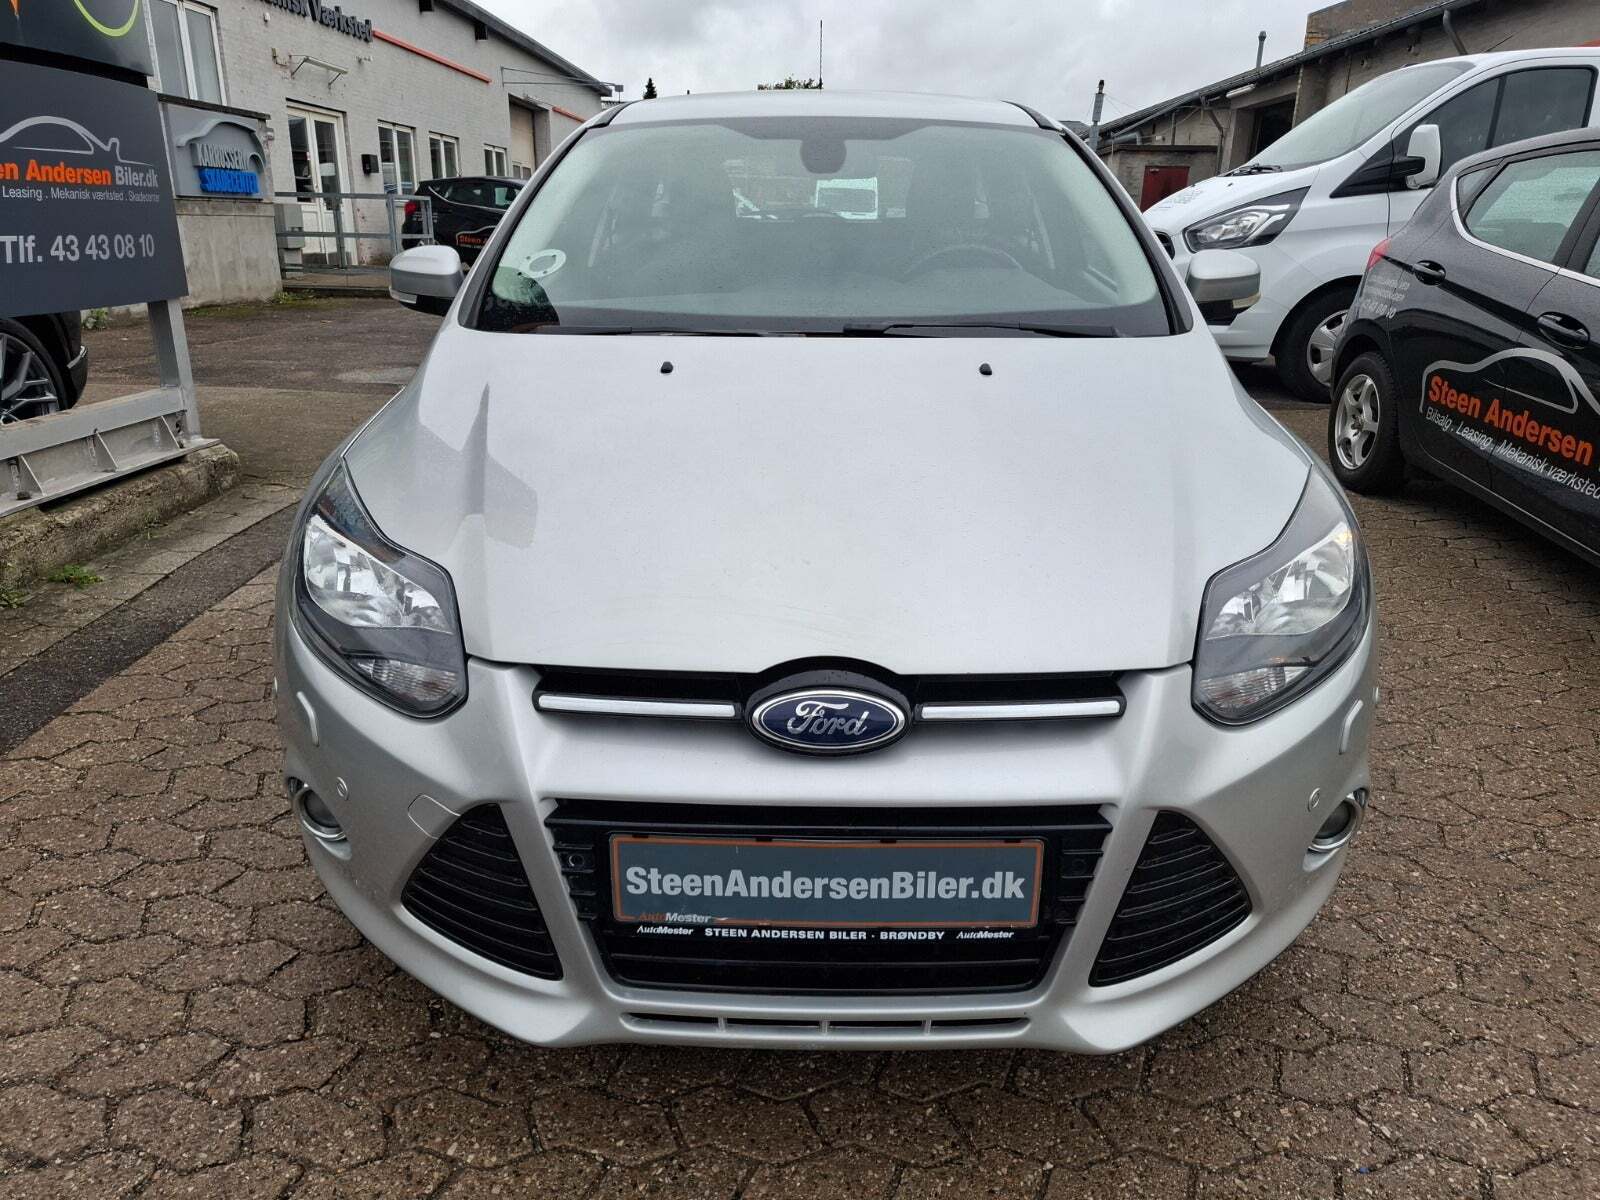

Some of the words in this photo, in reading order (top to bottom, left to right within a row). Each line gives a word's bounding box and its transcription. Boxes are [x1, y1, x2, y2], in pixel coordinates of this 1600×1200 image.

[307, 0, 372, 42] Værksted
[26, 159, 112, 185] Andersen
[114, 165, 159, 188] Biler.dk
[2, 185, 43, 202] Leasing
[51, 186, 91, 200] Mekanisk
[0, 235, 43, 263] Tlf.
[50, 235, 80, 261] 43
[85, 234, 110, 260] 43
[114, 233, 136, 259] 08
[139, 233, 155, 257] 10
[1429, 375, 1480, 418] Steen
[1484, 399, 1593, 466] Andersen
[1426, 406, 1453, 432] Bilsalg
[1456, 422, 1494, 450] Leasing
[1498, 439, 1549, 473] Mekanisk
[787, 700, 870, 736] Ford
[625, 865, 1025, 900] SteenAndersenBiler.dk
[637, 925, 694, 936] AutoMester
[704, 927, 748, 938] STEEN
[751, 929, 825, 940] ANDERSEN
[829, 931, 867, 941] BILER
[879, 931, 945, 941] BRØNDBY
[956, 930, 1014, 940] AutoMester
